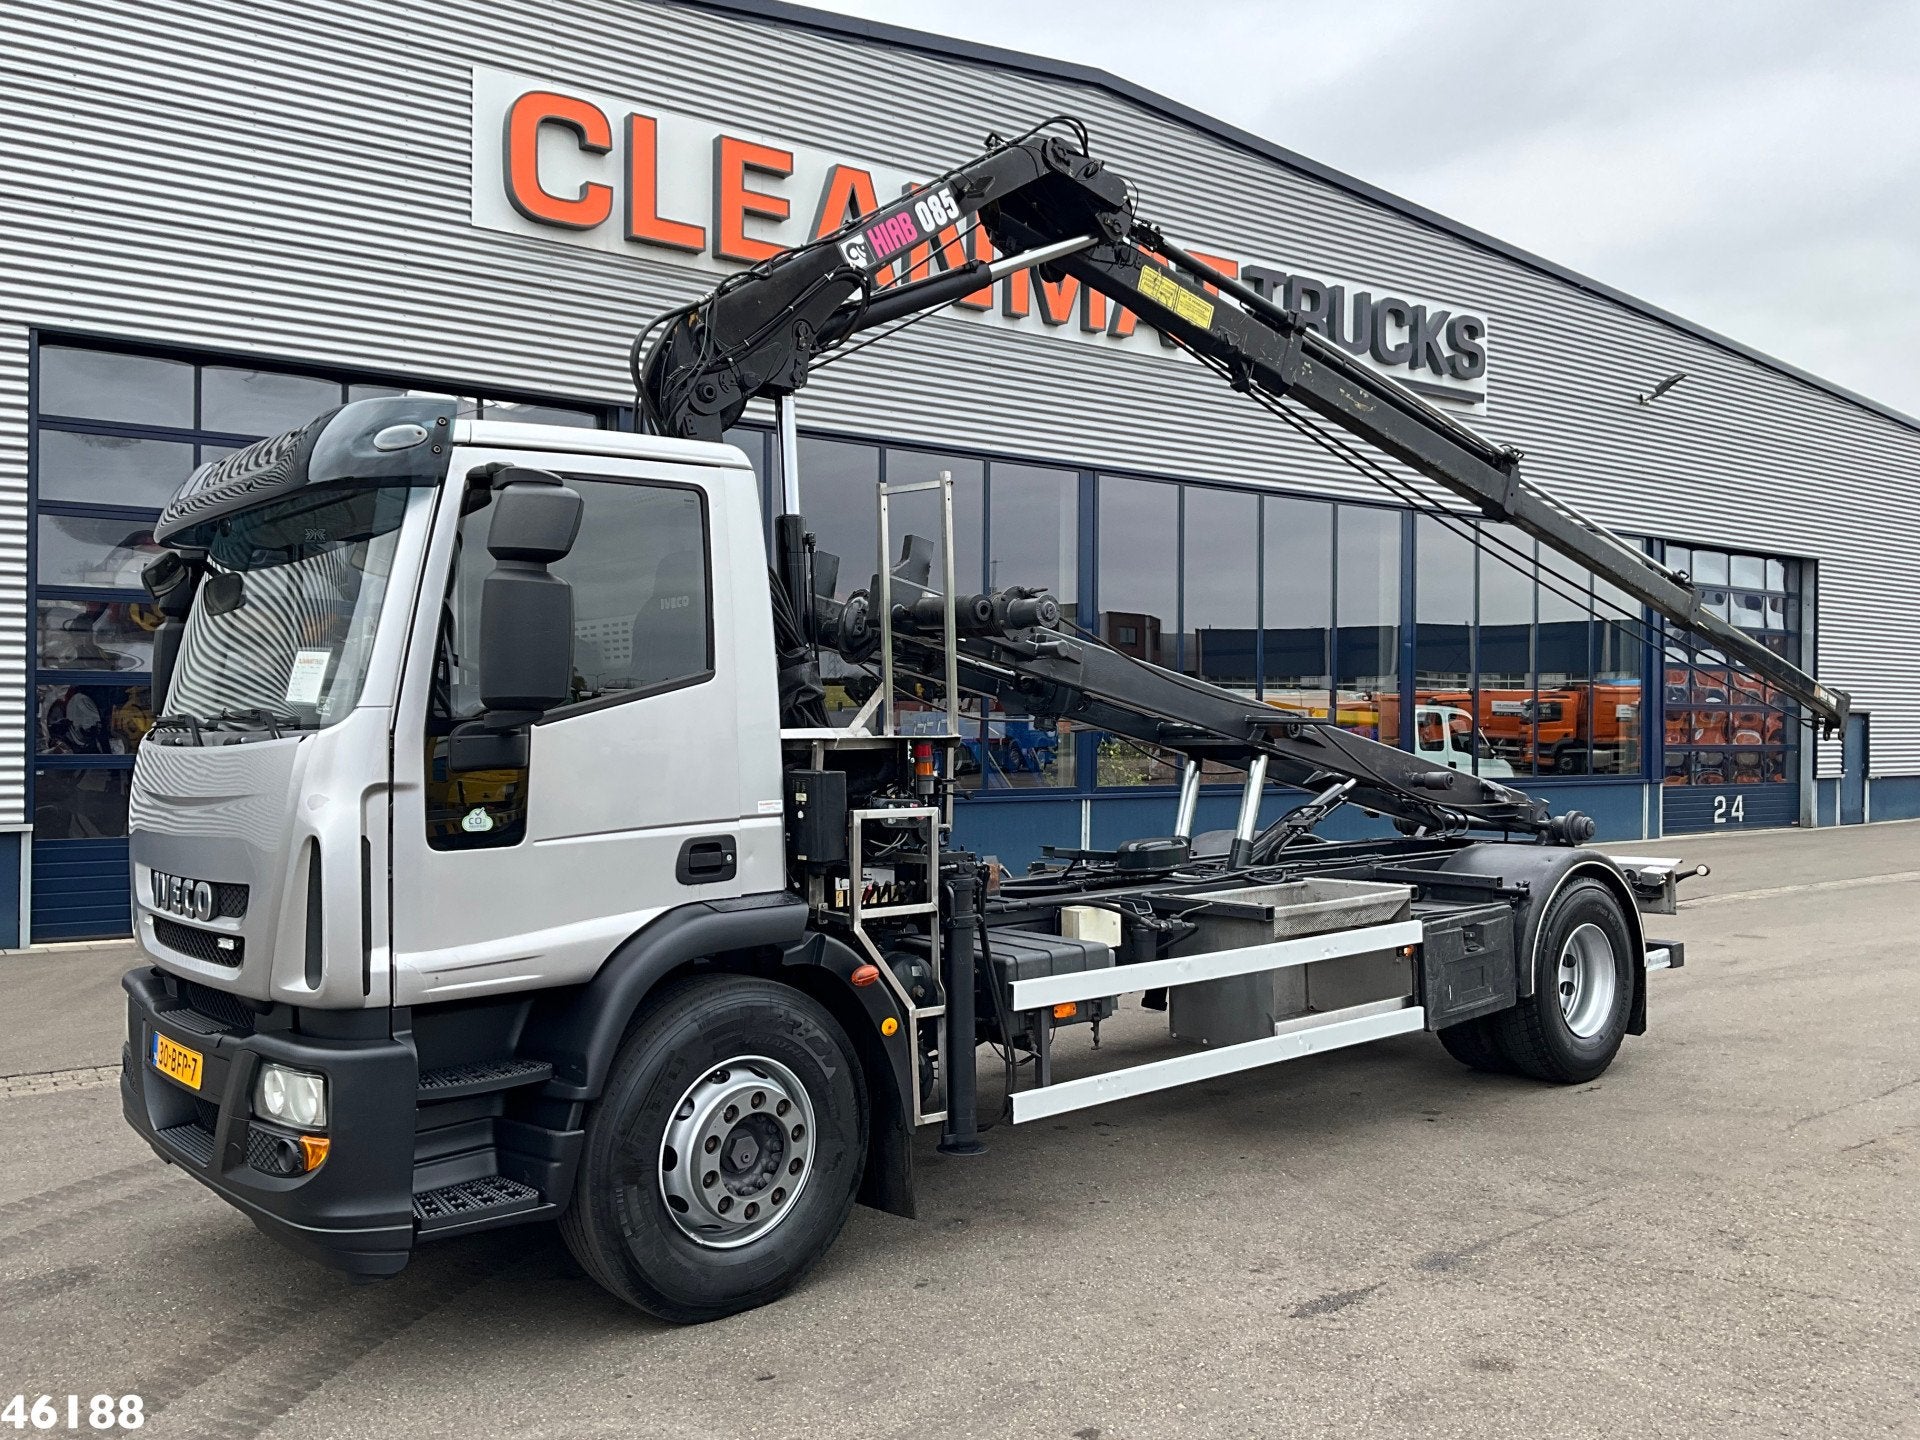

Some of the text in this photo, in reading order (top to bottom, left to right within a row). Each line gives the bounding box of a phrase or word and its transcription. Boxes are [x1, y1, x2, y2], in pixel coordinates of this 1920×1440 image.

[866, 187, 960, 259] HIAB 085
[1241, 264, 1487, 381] TRUCKS
[660, 595, 690, 610] IVECO
[1713, 794, 1745, 824] 24
[153, 871, 214, 922] IVECO
[158, 1041, 198, 1082] 30-BFP-7
